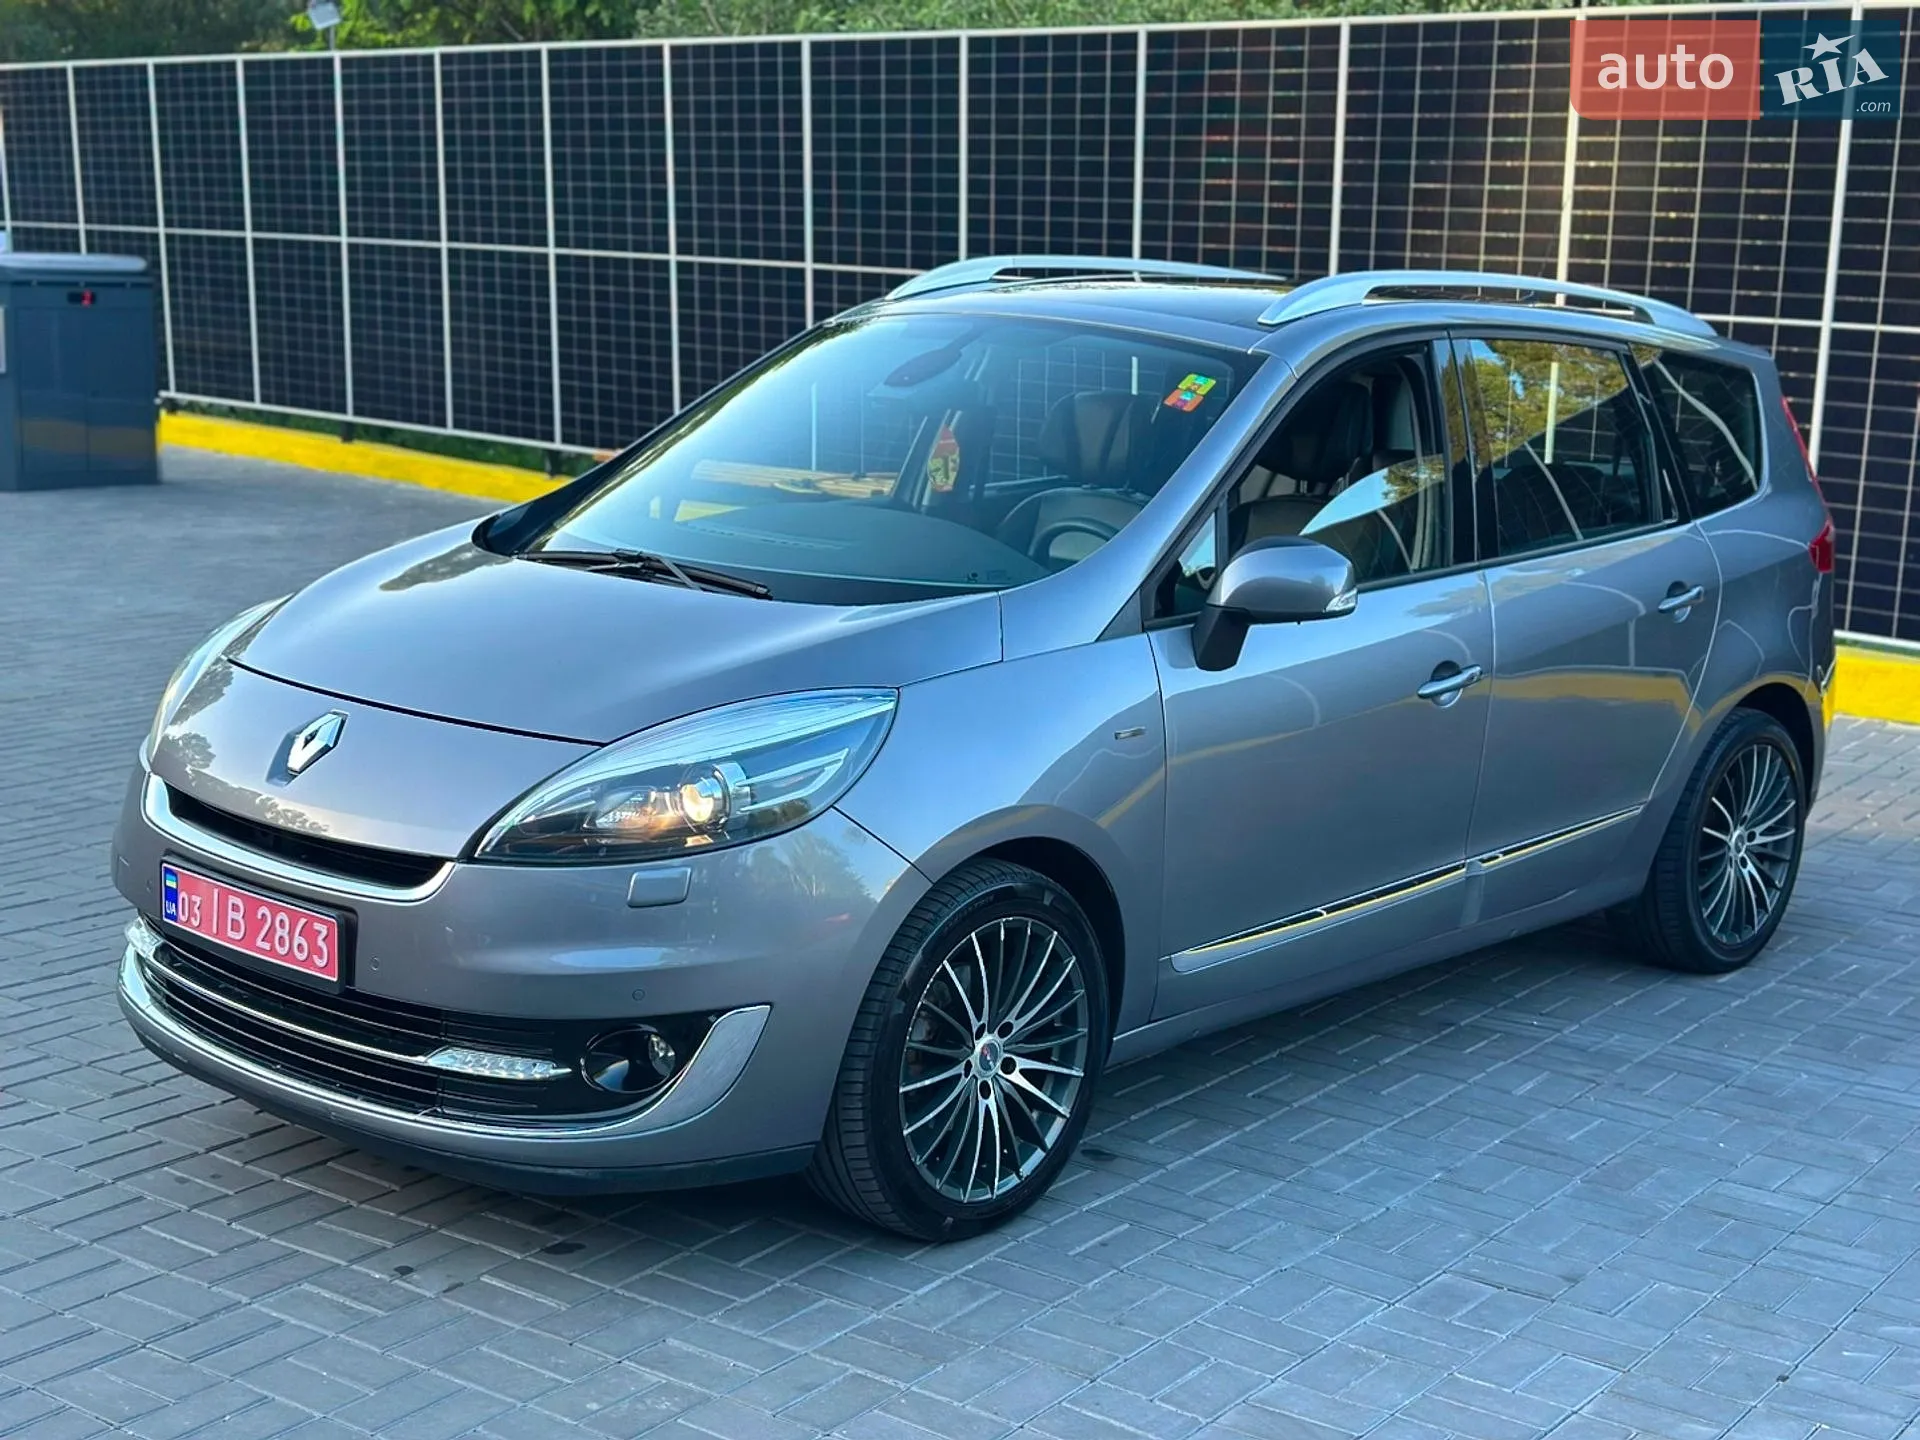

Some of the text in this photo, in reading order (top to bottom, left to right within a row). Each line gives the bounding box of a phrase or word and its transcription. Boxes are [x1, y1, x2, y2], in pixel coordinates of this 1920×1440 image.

[165, 900, 177, 916] UA
[179, 888, 329, 968] 03 IB 2863
